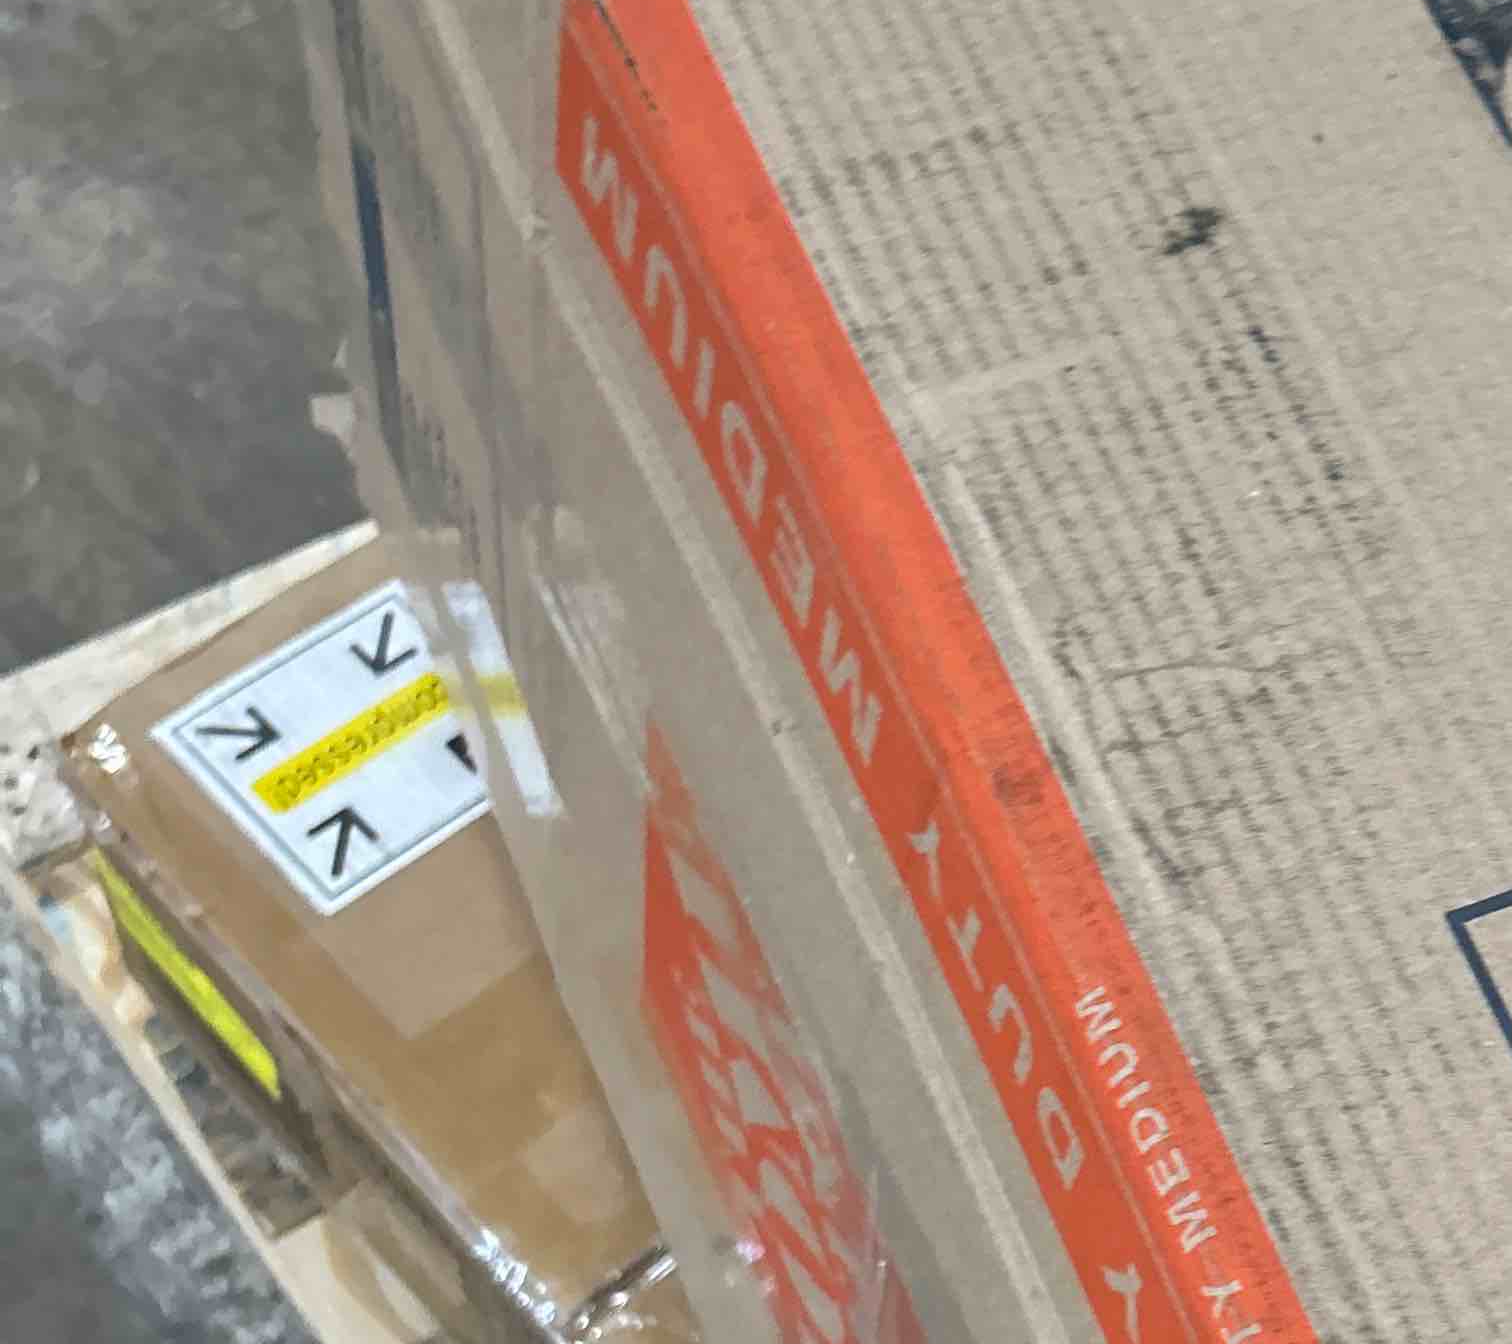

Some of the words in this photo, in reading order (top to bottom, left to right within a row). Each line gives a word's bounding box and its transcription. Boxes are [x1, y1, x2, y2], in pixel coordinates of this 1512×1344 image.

[580, 114, 884, 768] MEDIUM
[900, 828, 1084, 1190] DUTY
[1073, 983, 1218, 1253] MEDIUM
